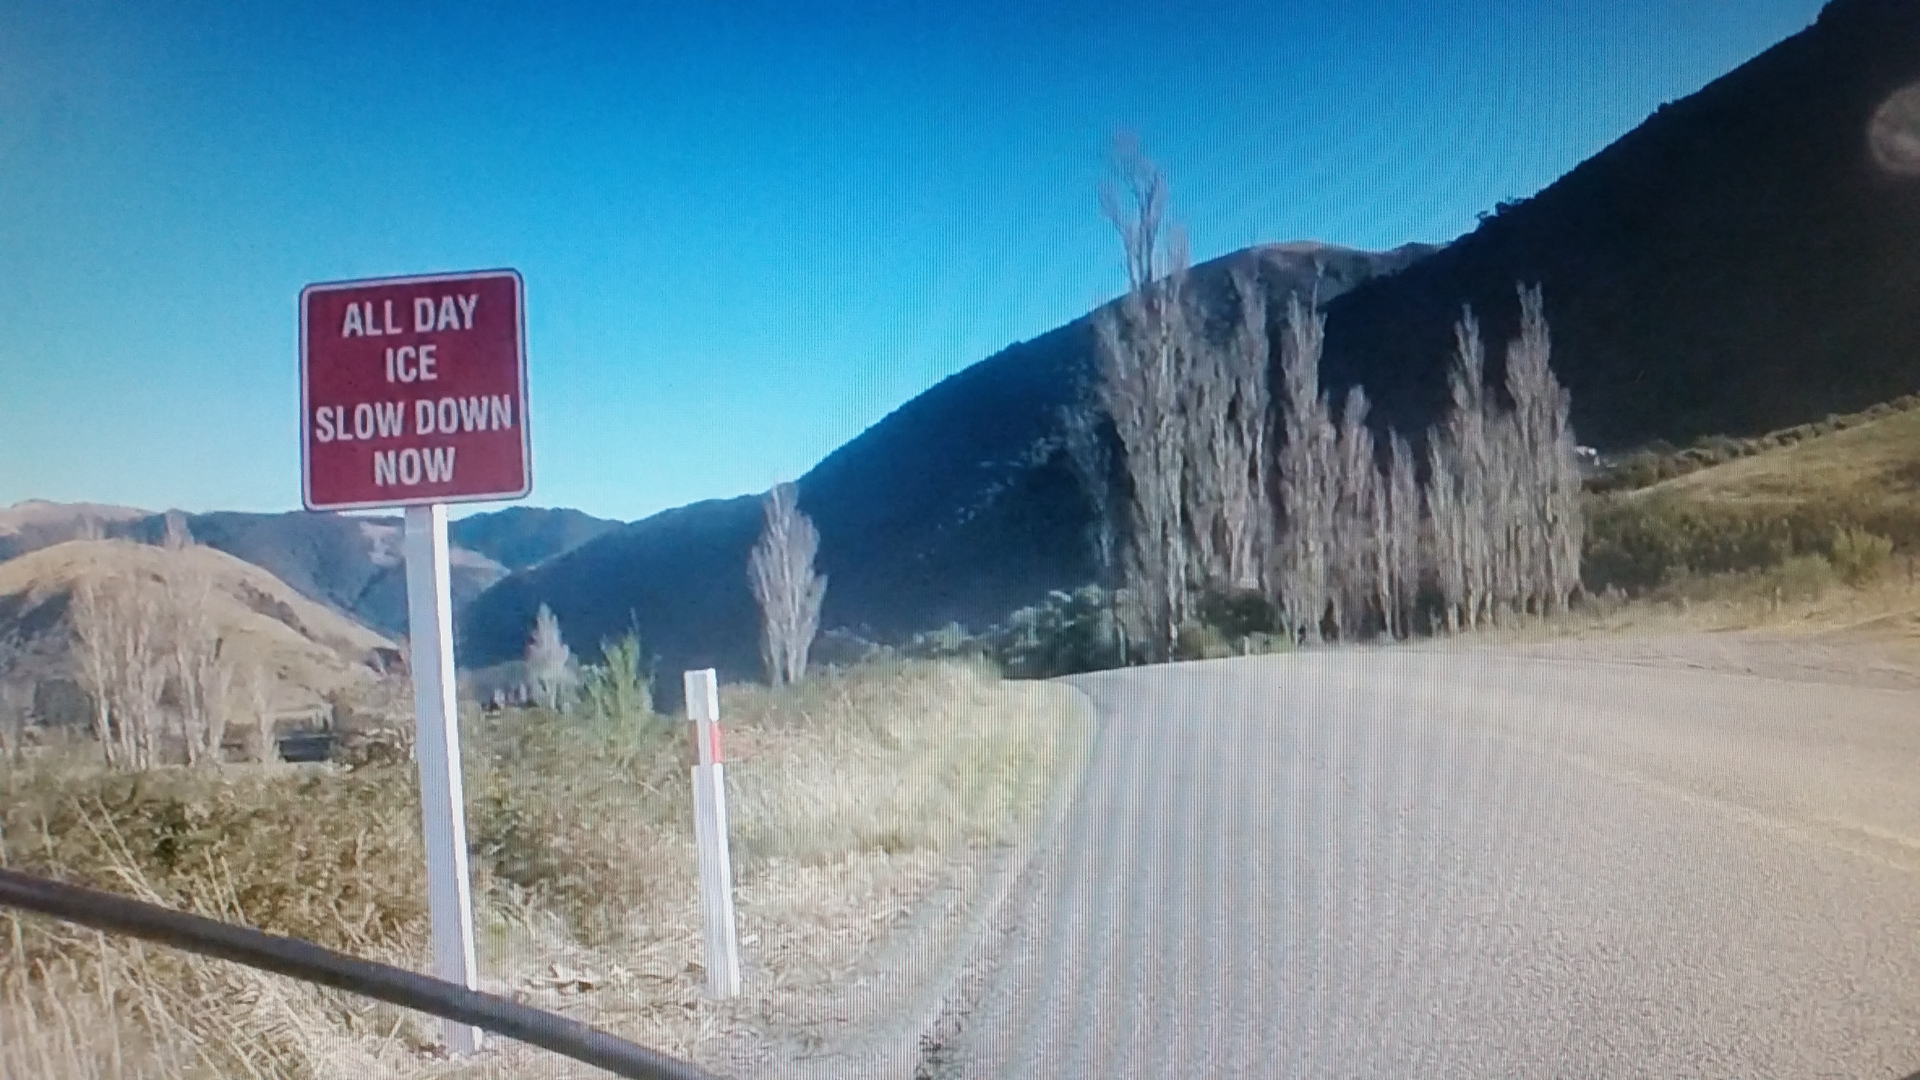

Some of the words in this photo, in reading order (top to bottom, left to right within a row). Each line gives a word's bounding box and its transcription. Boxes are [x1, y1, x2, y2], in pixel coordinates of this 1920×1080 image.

[342, 299, 403, 338] ALL
[414, 294, 479, 333] DAY
[385, 345, 438, 383] ICE
[315, 401, 405, 442] SLOW
[415, 394, 513, 435] DOWN
[374, 446, 456, 486] NOW
